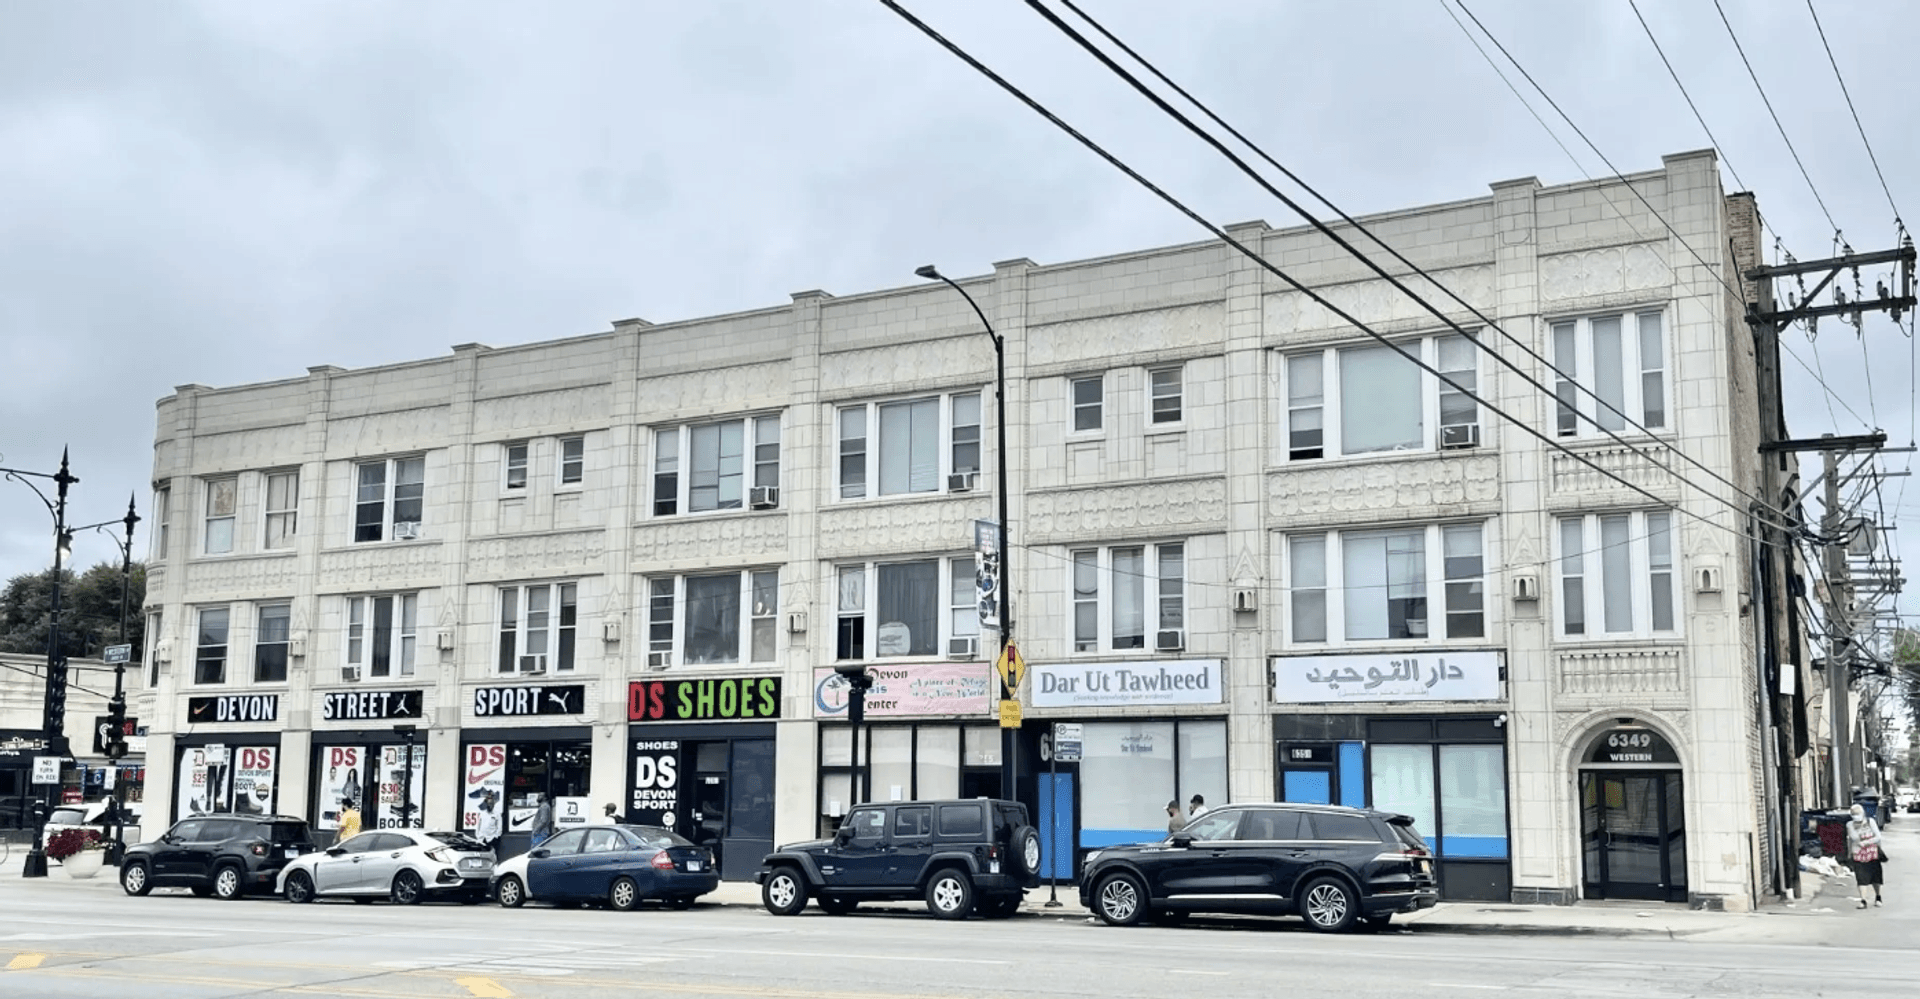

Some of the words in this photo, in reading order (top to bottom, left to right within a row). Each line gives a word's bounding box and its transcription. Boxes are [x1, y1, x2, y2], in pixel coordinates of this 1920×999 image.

[866, 667, 908, 680] Devon
[1040, 671, 1079, 693] Dar
[1085, 670, 1110, 692] Ut
[1114, 666, 1209, 692] Tawheed
[1305, 658, 1420, 689] التوحيد
[1425, 658, 1464, 688] دار
[324, 692, 391, 718] STREET
[475, 688, 542, 715] SPORT
[628, 681, 665, 720] DS
[677, 678, 775, 718] SHOES
[866, 700, 898, 710] enter
[216, 696, 275, 721] DEVON
[636, 741, 678, 751] SHOES
[1608, 733, 1651, 748] 6349
[242, 748, 271, 769] DS
[331, 747, 357, 767] DS
[397, 747, 425, 755] DEON
[470, 746, 505, 766] DS
[1610, 753, 1652, 762] WESTERN
[636, 755, 676, 788] DS
[234, 783, 257, 791] BOOTS
[380, 783, 398, 795] $30
[634, 789, 676, 800] DEVON
[381, 795, 398, 803] SALE
[633, 800, 677, 810] SPORT
